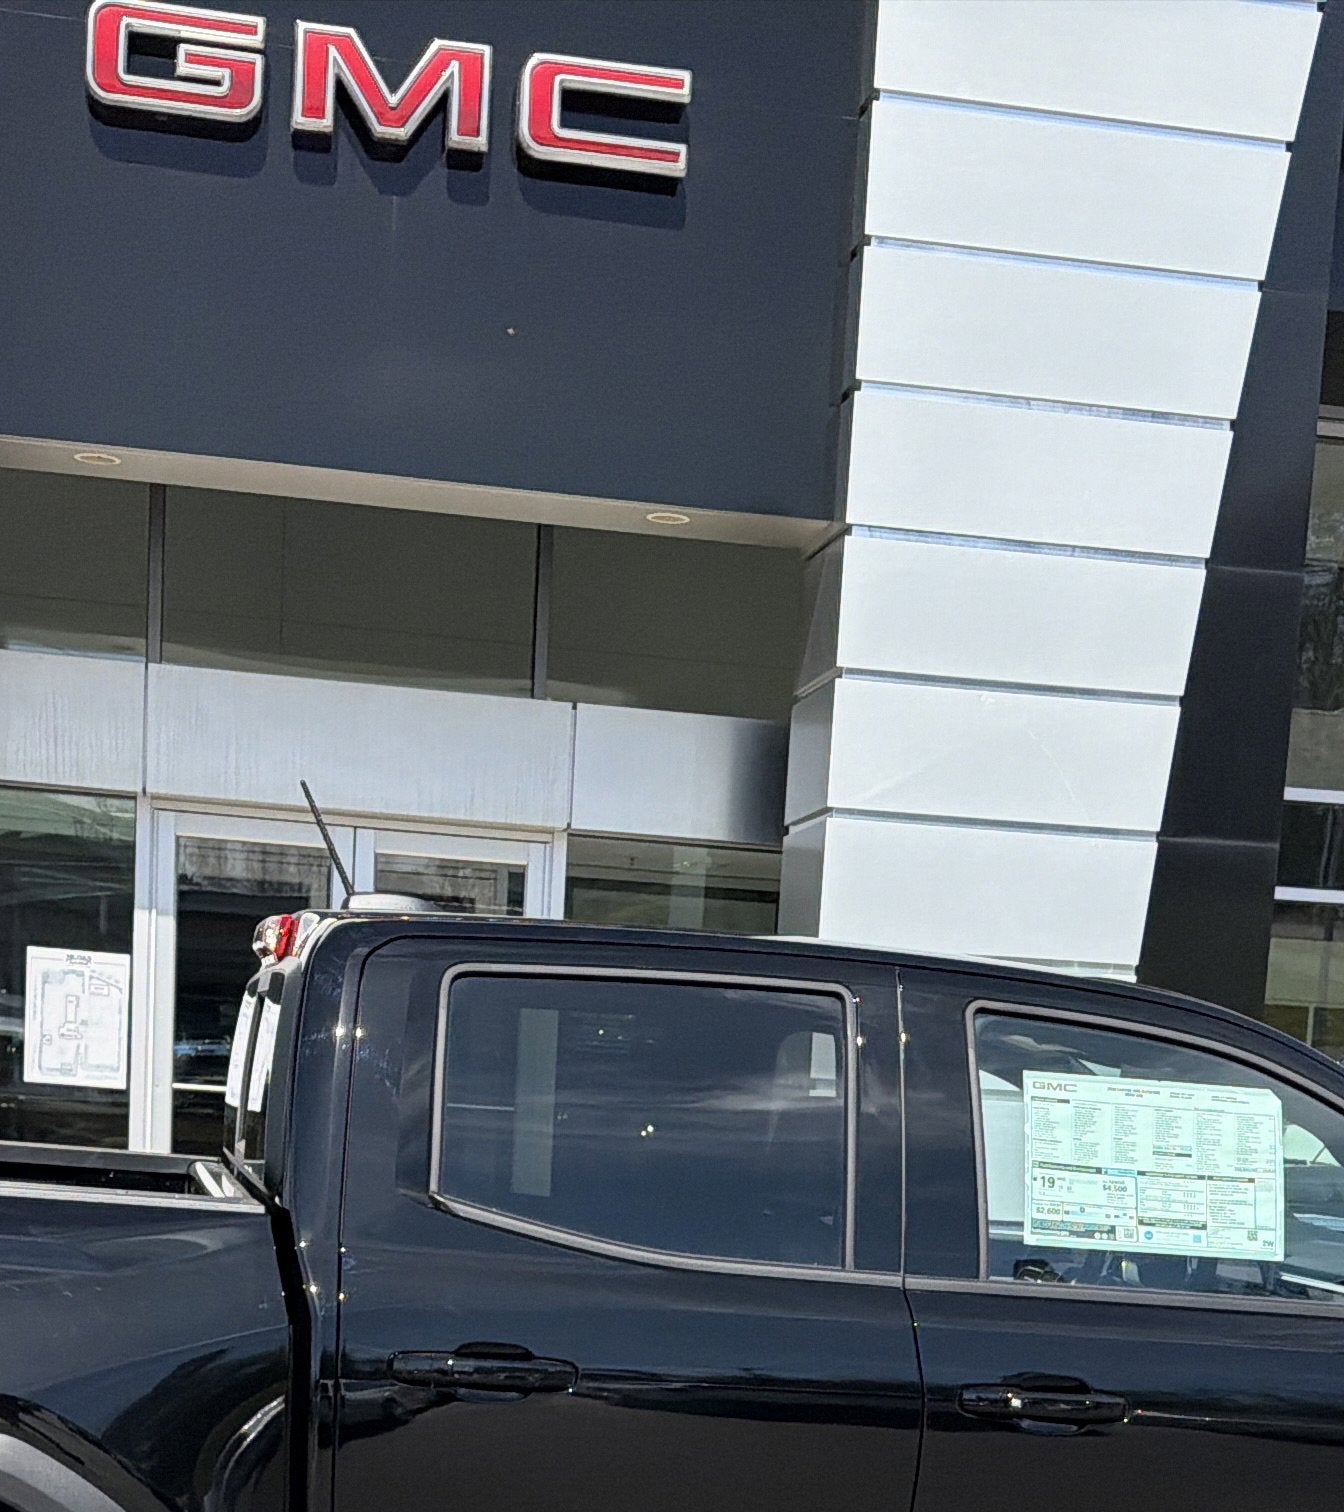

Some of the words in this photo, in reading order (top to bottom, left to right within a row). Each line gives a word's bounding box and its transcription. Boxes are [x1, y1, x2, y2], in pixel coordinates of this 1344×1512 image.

[85, 0, 693, 178] GMC
[1032, 1081, 1078, 1093] GMC
[1039, 1175, 1056, 1189] 19
